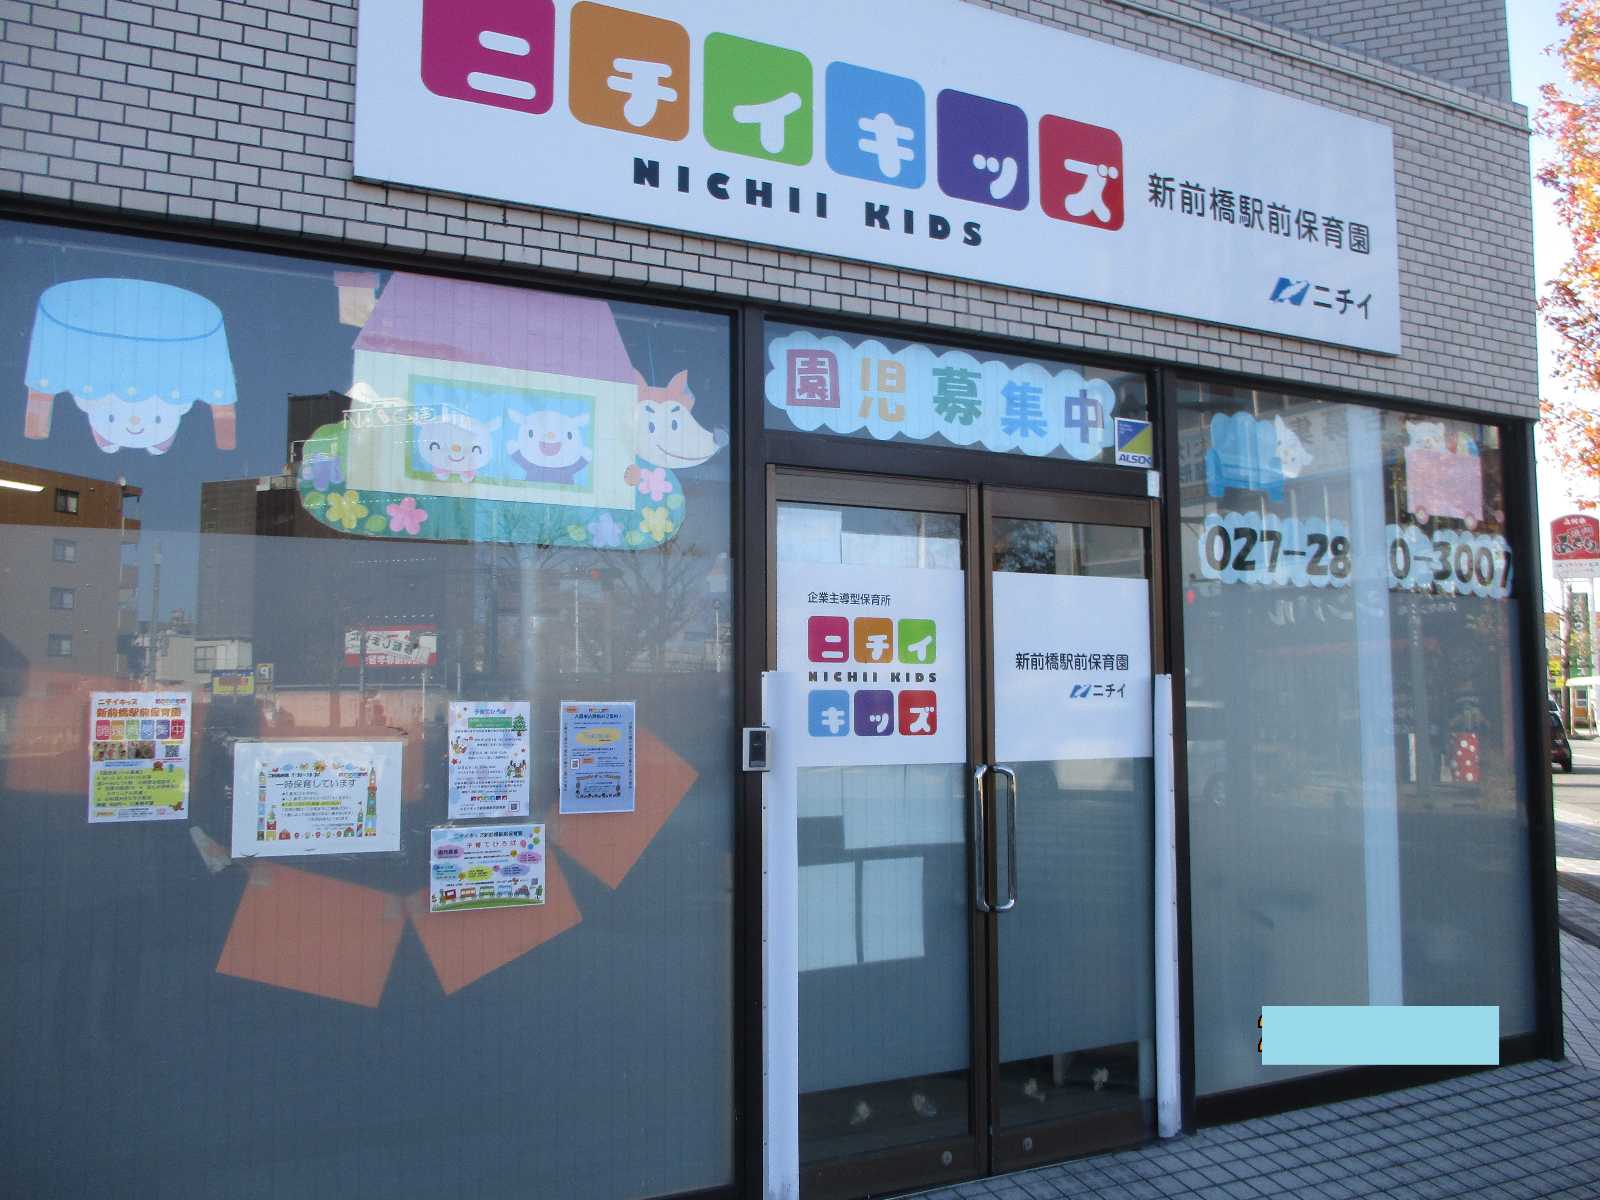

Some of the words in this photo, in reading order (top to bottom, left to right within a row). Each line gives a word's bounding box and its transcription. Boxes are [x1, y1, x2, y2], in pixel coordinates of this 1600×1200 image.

[632, 157, 828, 220] NICHII
[864, 201, 983, 247] KIDS
[1148, 172, 1371, 256] 新前橋駅前保育園
[1313, 285, 1372, 320] ニチイ
[786, 348, 1104, 444] 園児募集中
[807, 591, 891, 607] 企業主導型保育所
[1015, 652, 1129, 672] 新前橋駅前保育園
[808, 672, 878, 682] NICHII
[891, 672, 937, 683] KIDS
[1093, 683, 1127, 699] ニチイ
